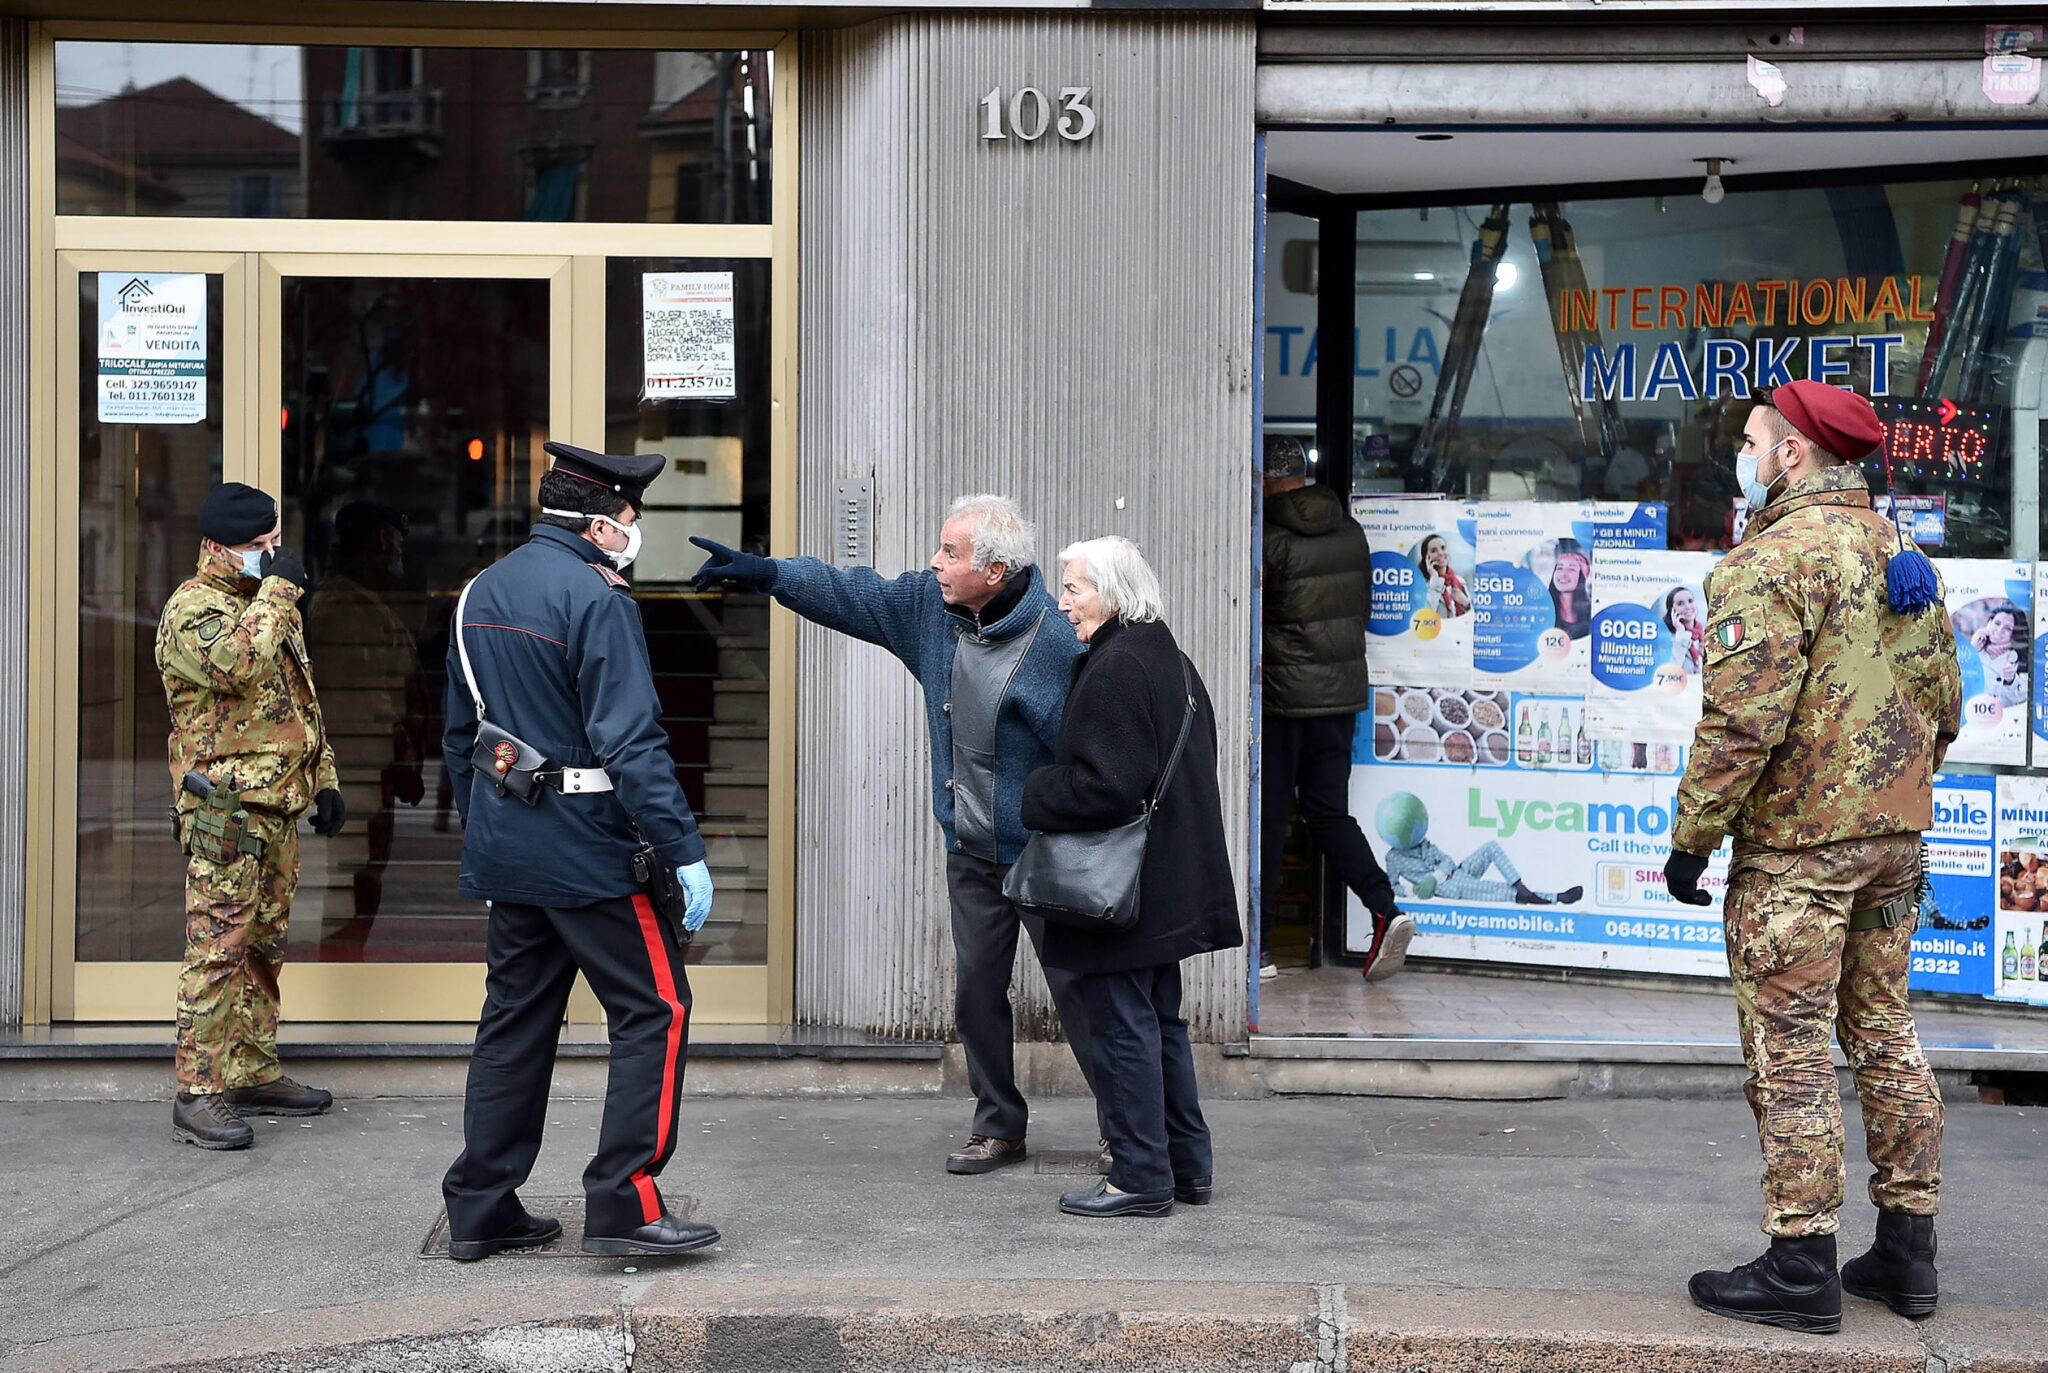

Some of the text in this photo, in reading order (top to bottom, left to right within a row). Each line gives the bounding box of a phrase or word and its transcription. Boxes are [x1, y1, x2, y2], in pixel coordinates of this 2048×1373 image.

[980, 86, 1096, 141] 103
[1559, 275, 1936, 332] INTERNATIONAL
[689, 309, 722, 319] STABILE
[146, 340, 200, 350] VENDITA
[99, 359, 146, 368] TRILOCALE
[1580, 333, 1905, 402] MARKET
[106, 380, 197, 390] Cell. 329.9659147
[109, 391, 195, 401] Tel. 011.7601328
[1354, 507, 1399, 516] Lycamobile
[1389, 522, 1436, 532] Lycamobile
[1601, 529, 1614, 537] GB
[1623, 529, 1657, 538] MINUTI
[1594, 557, 1642, 566] Lycamobile
[1595, 572, 1621, 580] Passa
[1631, 574, 1683, 583] Lycamobile
[1503, 594, 1523, 605] 100
[1600, 619, 1658, 640] 60GB
[1545, 637, 1565, 646] 12€
[1598, 655, 1625, 664] Minuti
[1633, 657, 1655, 666] SMS
[1606, 664, 1646, 675] Nazionali
[1974, 703, 1996, 714] 10€
[1468, 788, 1677, 837] Lycamo
[1953, 826, 1967, 835] for
[1588, 838, 1620, 853] Call
[1624, 840, 1651, 854] the
[1966, 863, 1985, 871] qui
[1406, 910, 1575, 934] www.lycamobile.it
[1912, 957, 1961, 975] 2322
